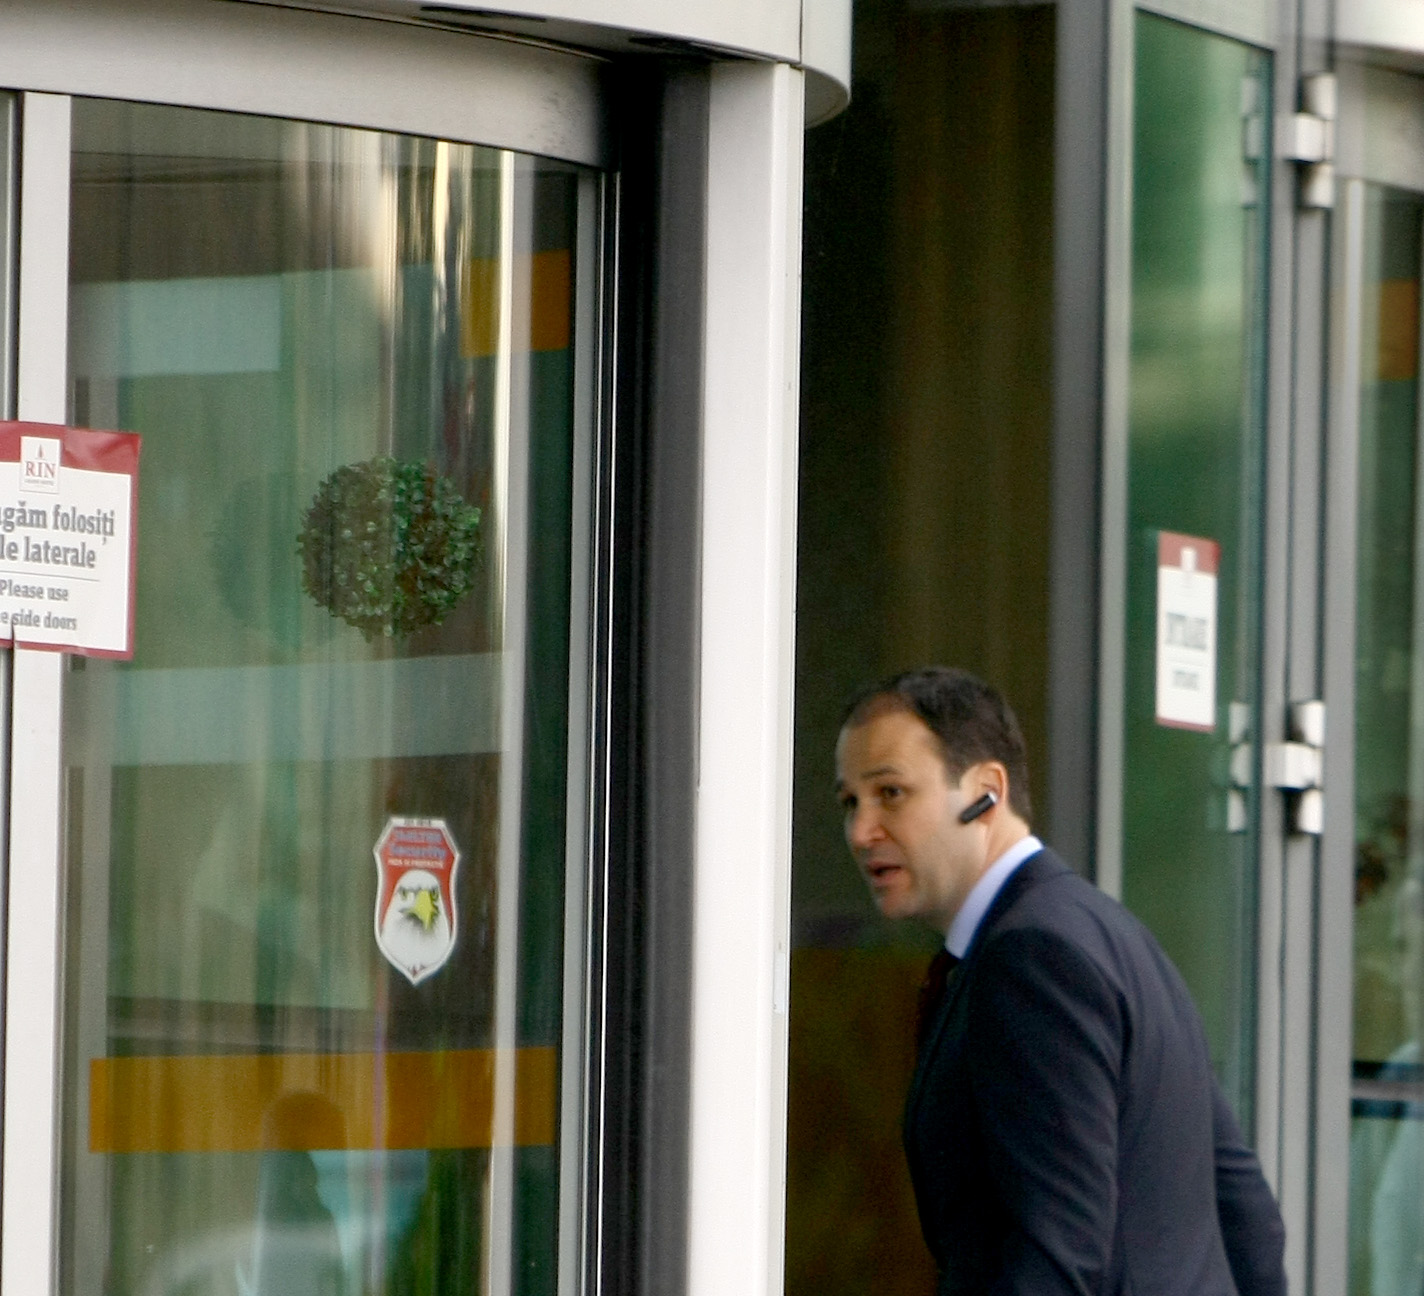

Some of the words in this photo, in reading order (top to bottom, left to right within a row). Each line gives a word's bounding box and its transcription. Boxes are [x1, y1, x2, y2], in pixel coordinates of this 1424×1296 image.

[25, 460, 56, 479] RIN
[0, 500, 47, 533] găm
[0, 534, 18, 561] le
[24, 535, 96, 568] laterale
[0, 579, 44, 599] Please
[47, 587, 69, 601] use
[11, 609, 40, 627] side
[44, 611, 78, 630] doors
